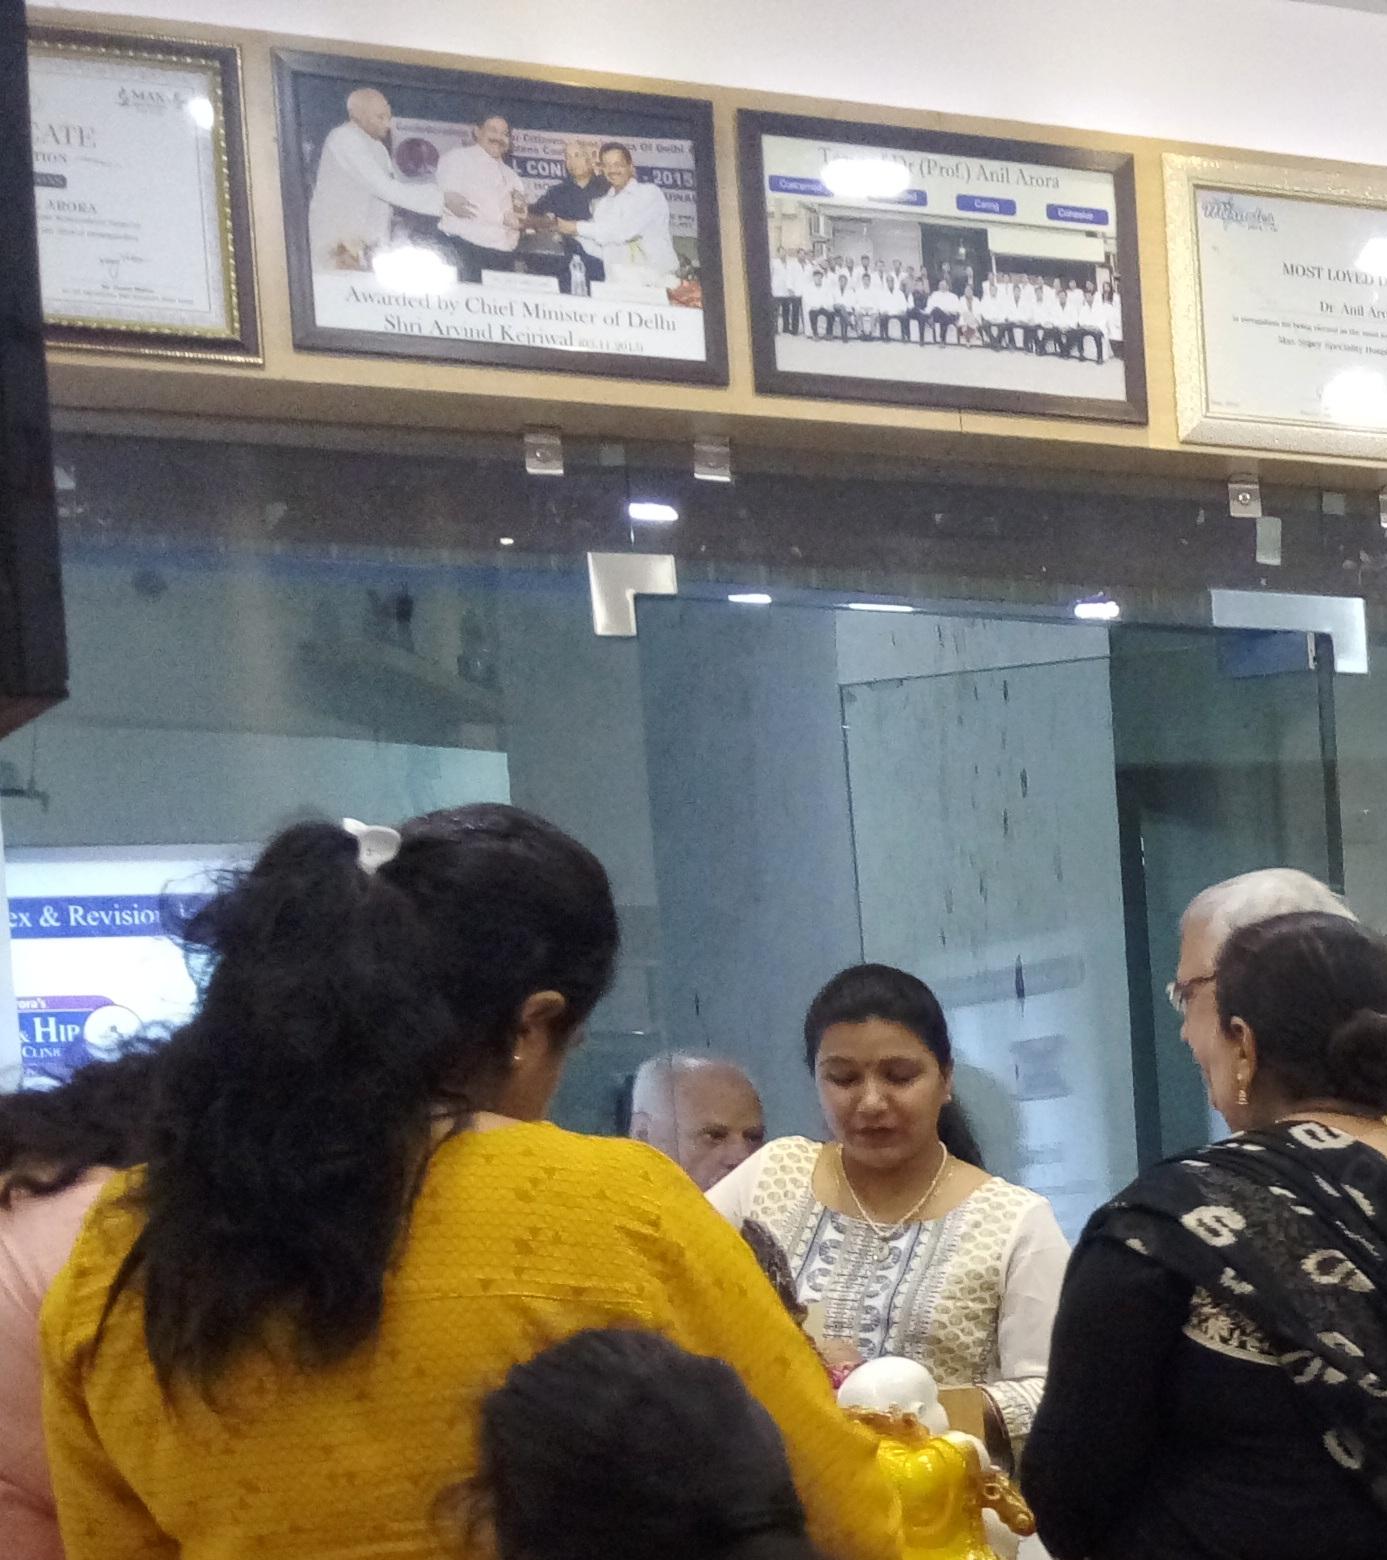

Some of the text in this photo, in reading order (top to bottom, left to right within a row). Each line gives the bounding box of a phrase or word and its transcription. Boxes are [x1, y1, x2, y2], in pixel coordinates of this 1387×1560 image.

[977, 165, 1012, 185] Anil
[1014, 169, 1060, 189] Arora
[1282, 261, 1374, 286] MOST LOVED
[465, 299, 514, 318] Chief
[522, 302, 595, 326] Minister
[604, 308, 623, 327] of
[627, 310, 677, 332] Delhi
[1343, 304, 1364, 317] Anil
[384, 314, 422, 335] Shri
[430, 318, 493, 340] Arvind
[39, 906, 61, 927] &
